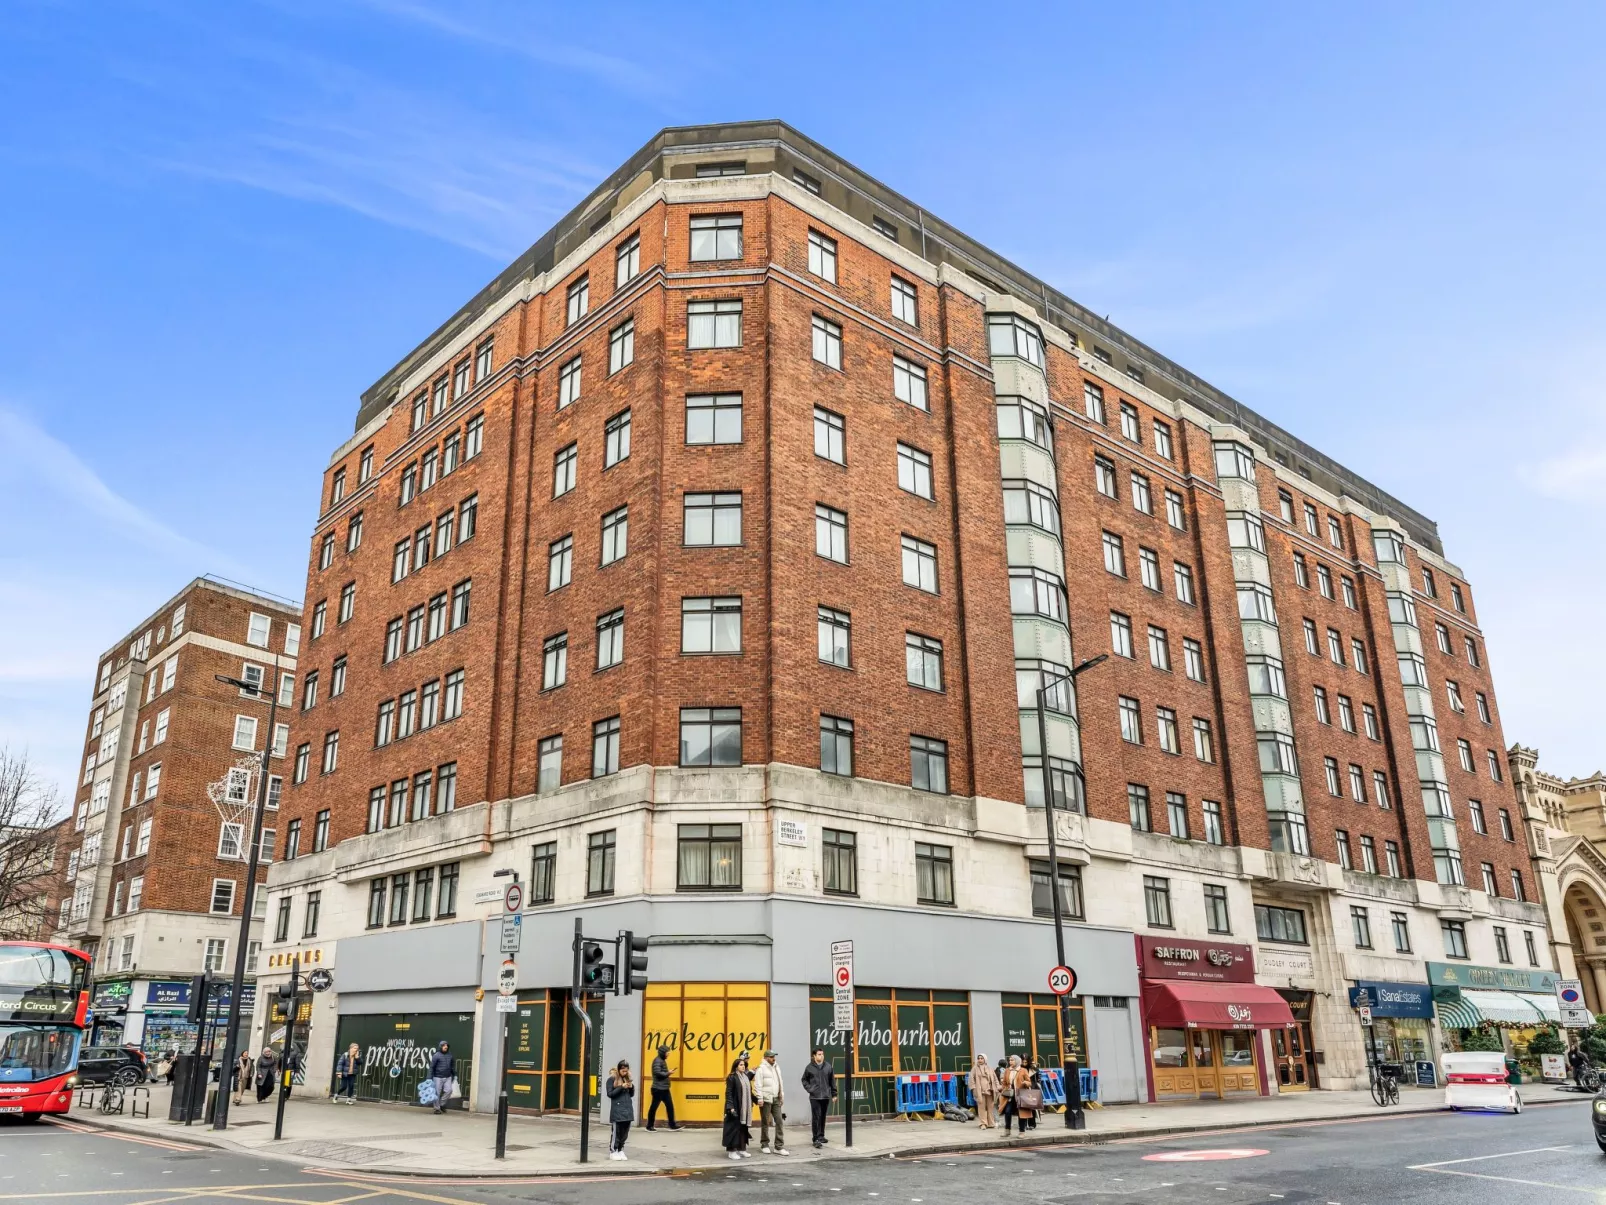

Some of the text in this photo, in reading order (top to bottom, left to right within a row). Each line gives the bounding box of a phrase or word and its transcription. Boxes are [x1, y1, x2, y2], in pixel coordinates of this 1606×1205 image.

[781, 827, 803, 835] BERKELEY
[781, 832, 797, 840] STREET
[269, 949, 322, 968] CREAMS
[1155, 946, 1200, 961] SAFFRON
[1264, 959, 1307, 969] DUDLEY COURT
[1052, 974, 1069, 986] 20
[1468, 968, 1499, 986] GREEN
[1500, 971, 1532, 989] VALLEY
[24, 1001, 57, 1011] Circus
[61, 1001, 73, 1013] 7
[1289, 1001, 1308, 1009] COURT
[815, 1020, 962, 1053] neihbourhood
[362, 1044, 437, 1078] progress
